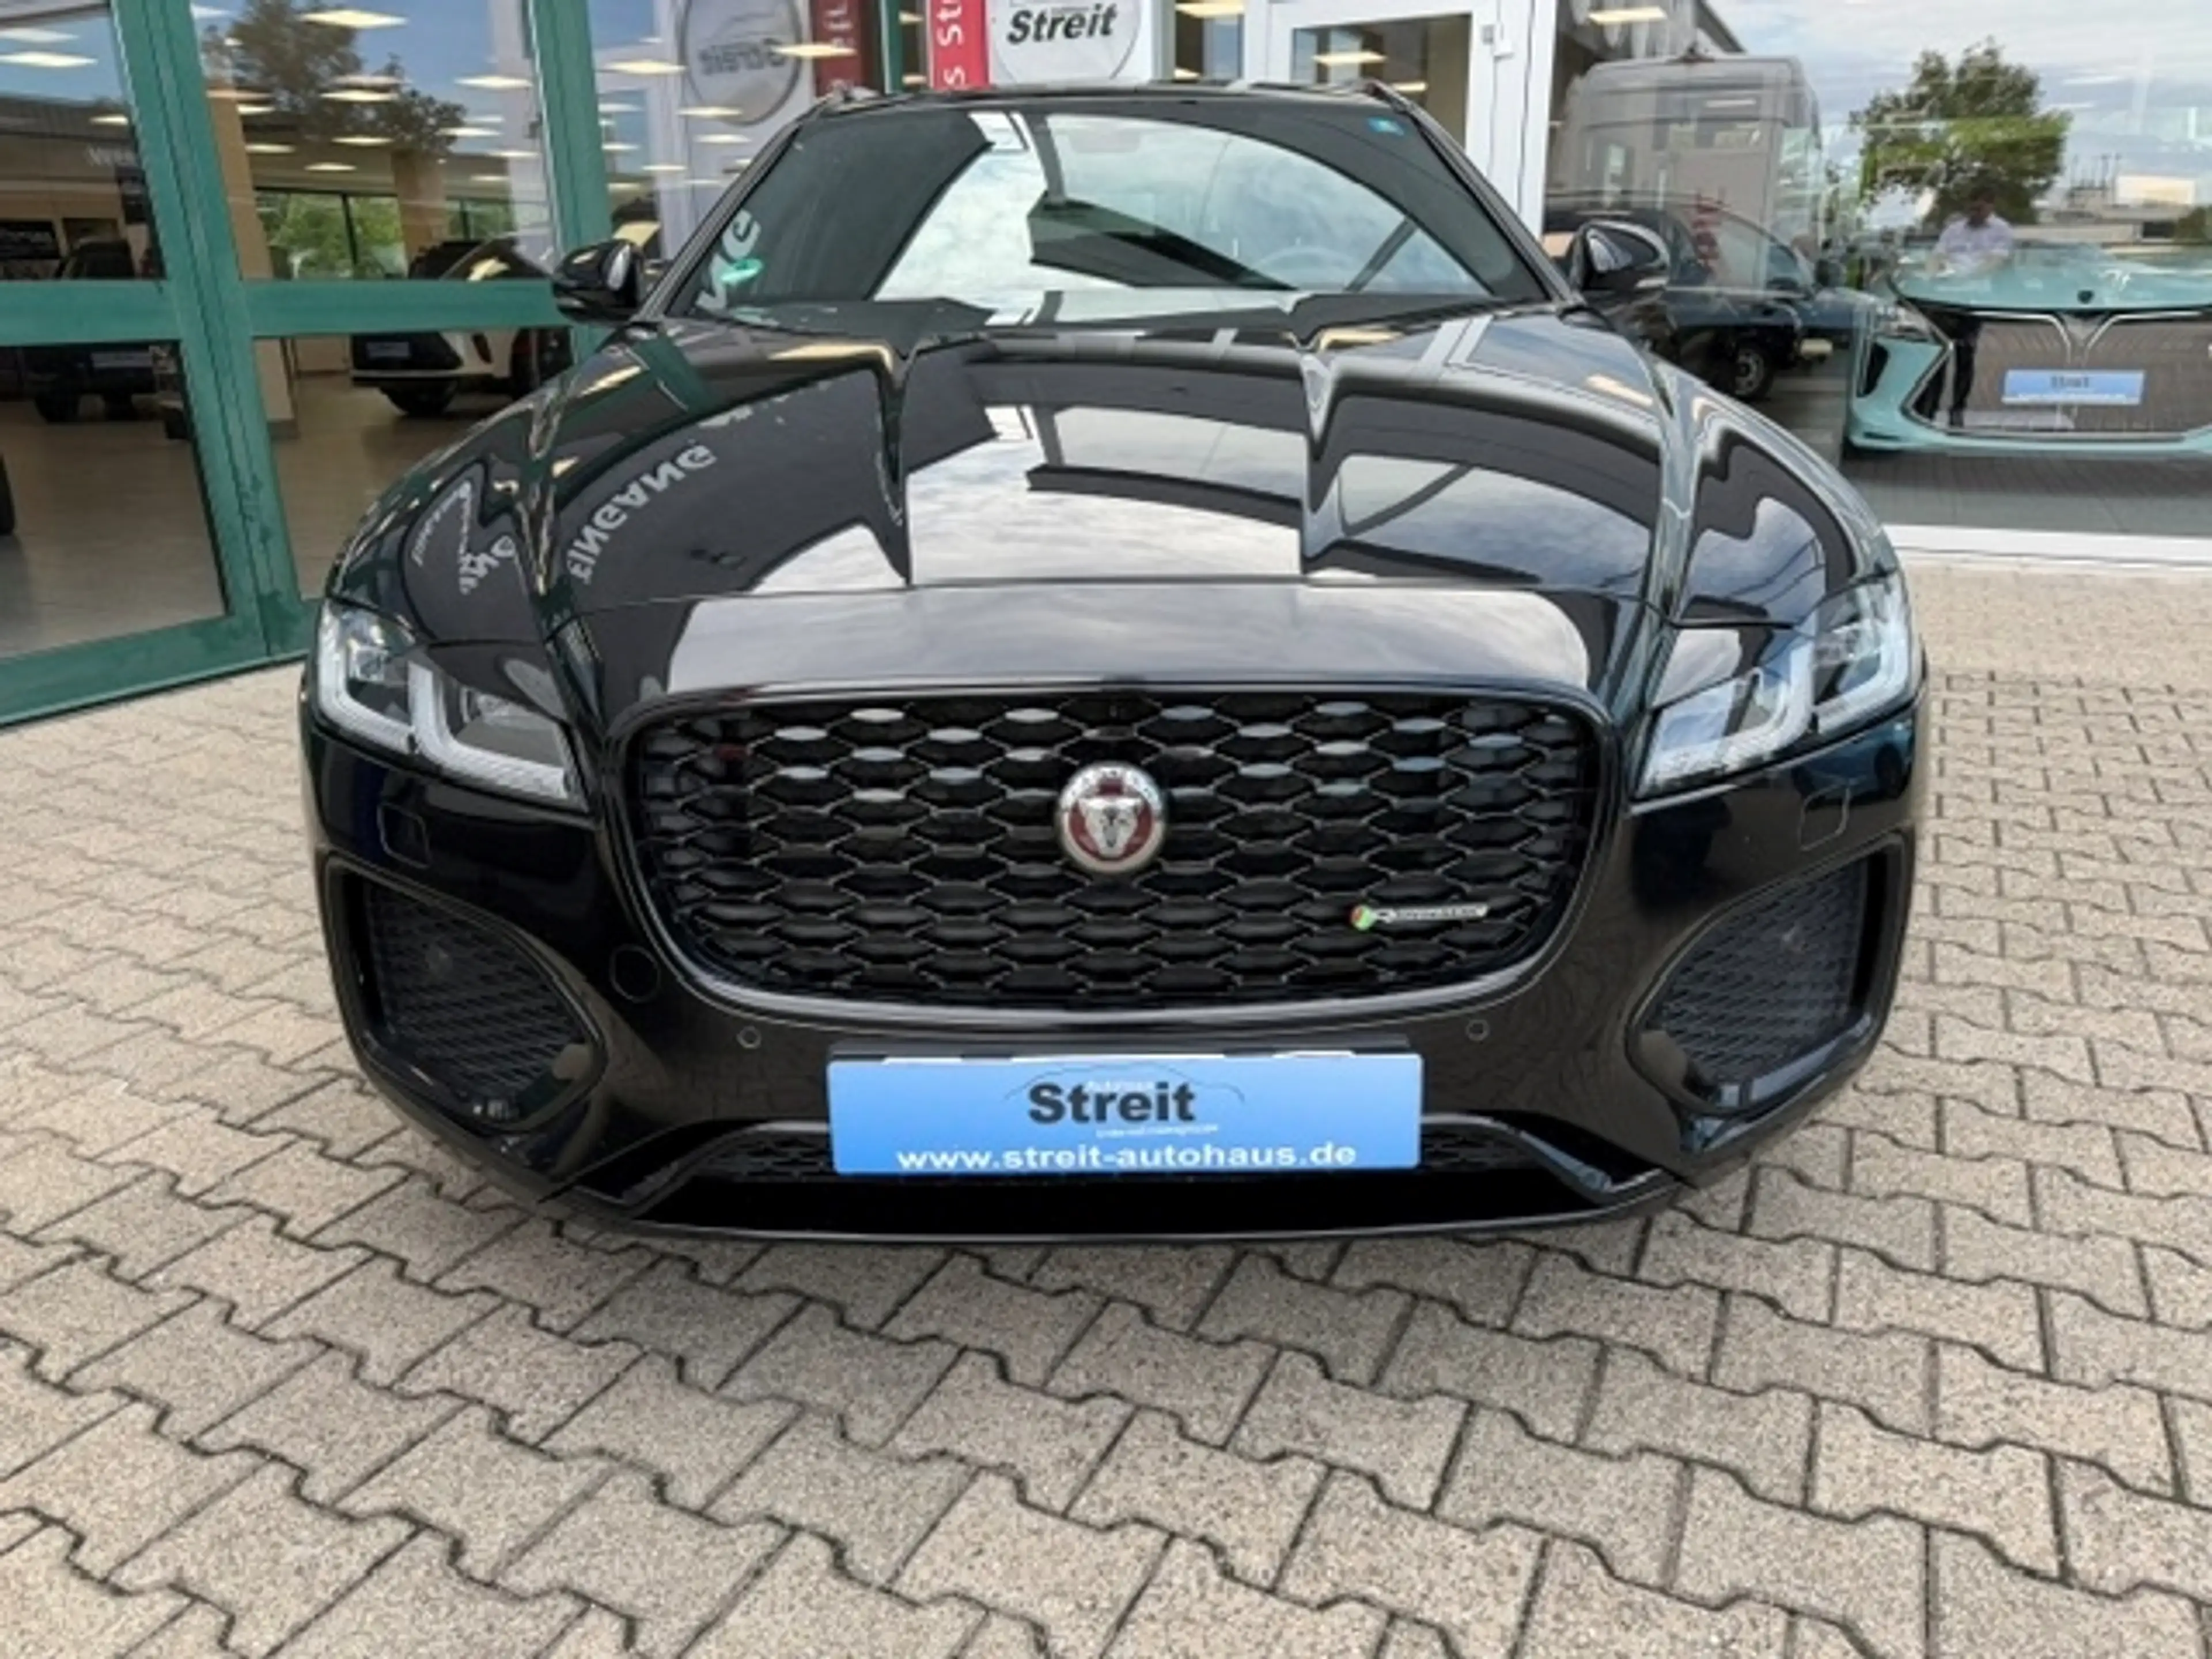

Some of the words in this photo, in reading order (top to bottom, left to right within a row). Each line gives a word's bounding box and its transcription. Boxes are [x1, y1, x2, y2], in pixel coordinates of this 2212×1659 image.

[1006, 3, 1118, 45] Streit
[1028, 1081, 1196, 1124] Streit
[896, 1141, 1357, 1169] www.streit-autohaus.de
